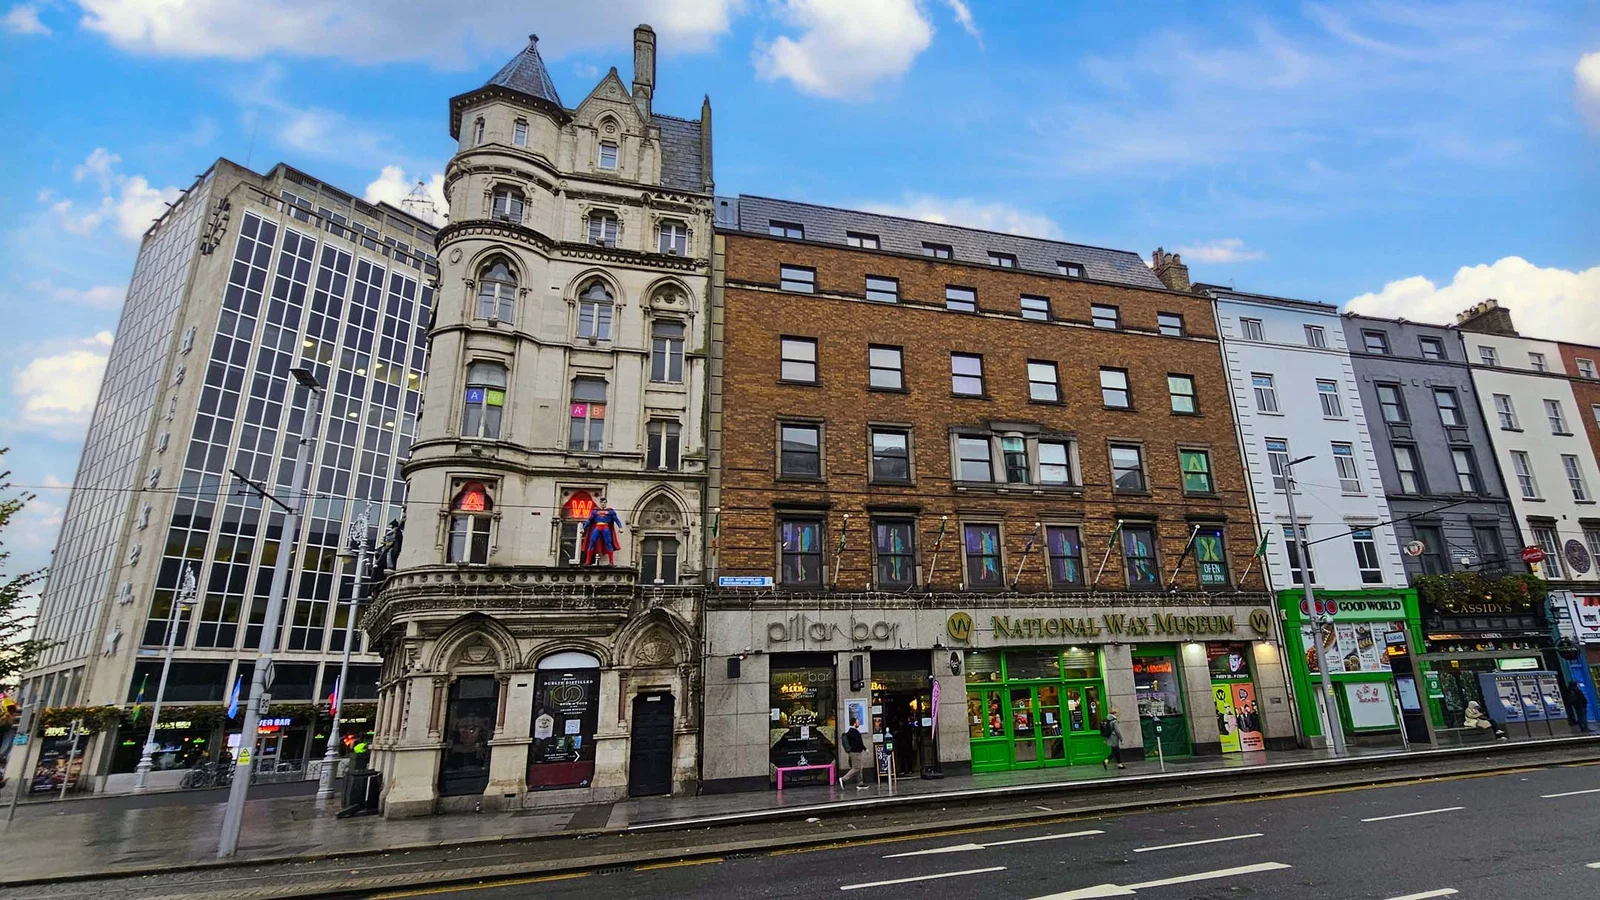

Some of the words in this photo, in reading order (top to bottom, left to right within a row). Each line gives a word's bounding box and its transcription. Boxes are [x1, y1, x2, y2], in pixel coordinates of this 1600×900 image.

[461, 492, 484, 511] A
[571, 500, 594, 519] W
[1339, 601, 1366, 611] GOOD
[1366, 600, 1401, 611] WORLD
[850, 614, 900, 649] bar
[992, 614, 1101, 639] NATIONAL
[1103, 612, 1150, 635] WAX
[1152, 612, 1236, 635] MUSEUM
[272, 717, 288, 725] BAR
